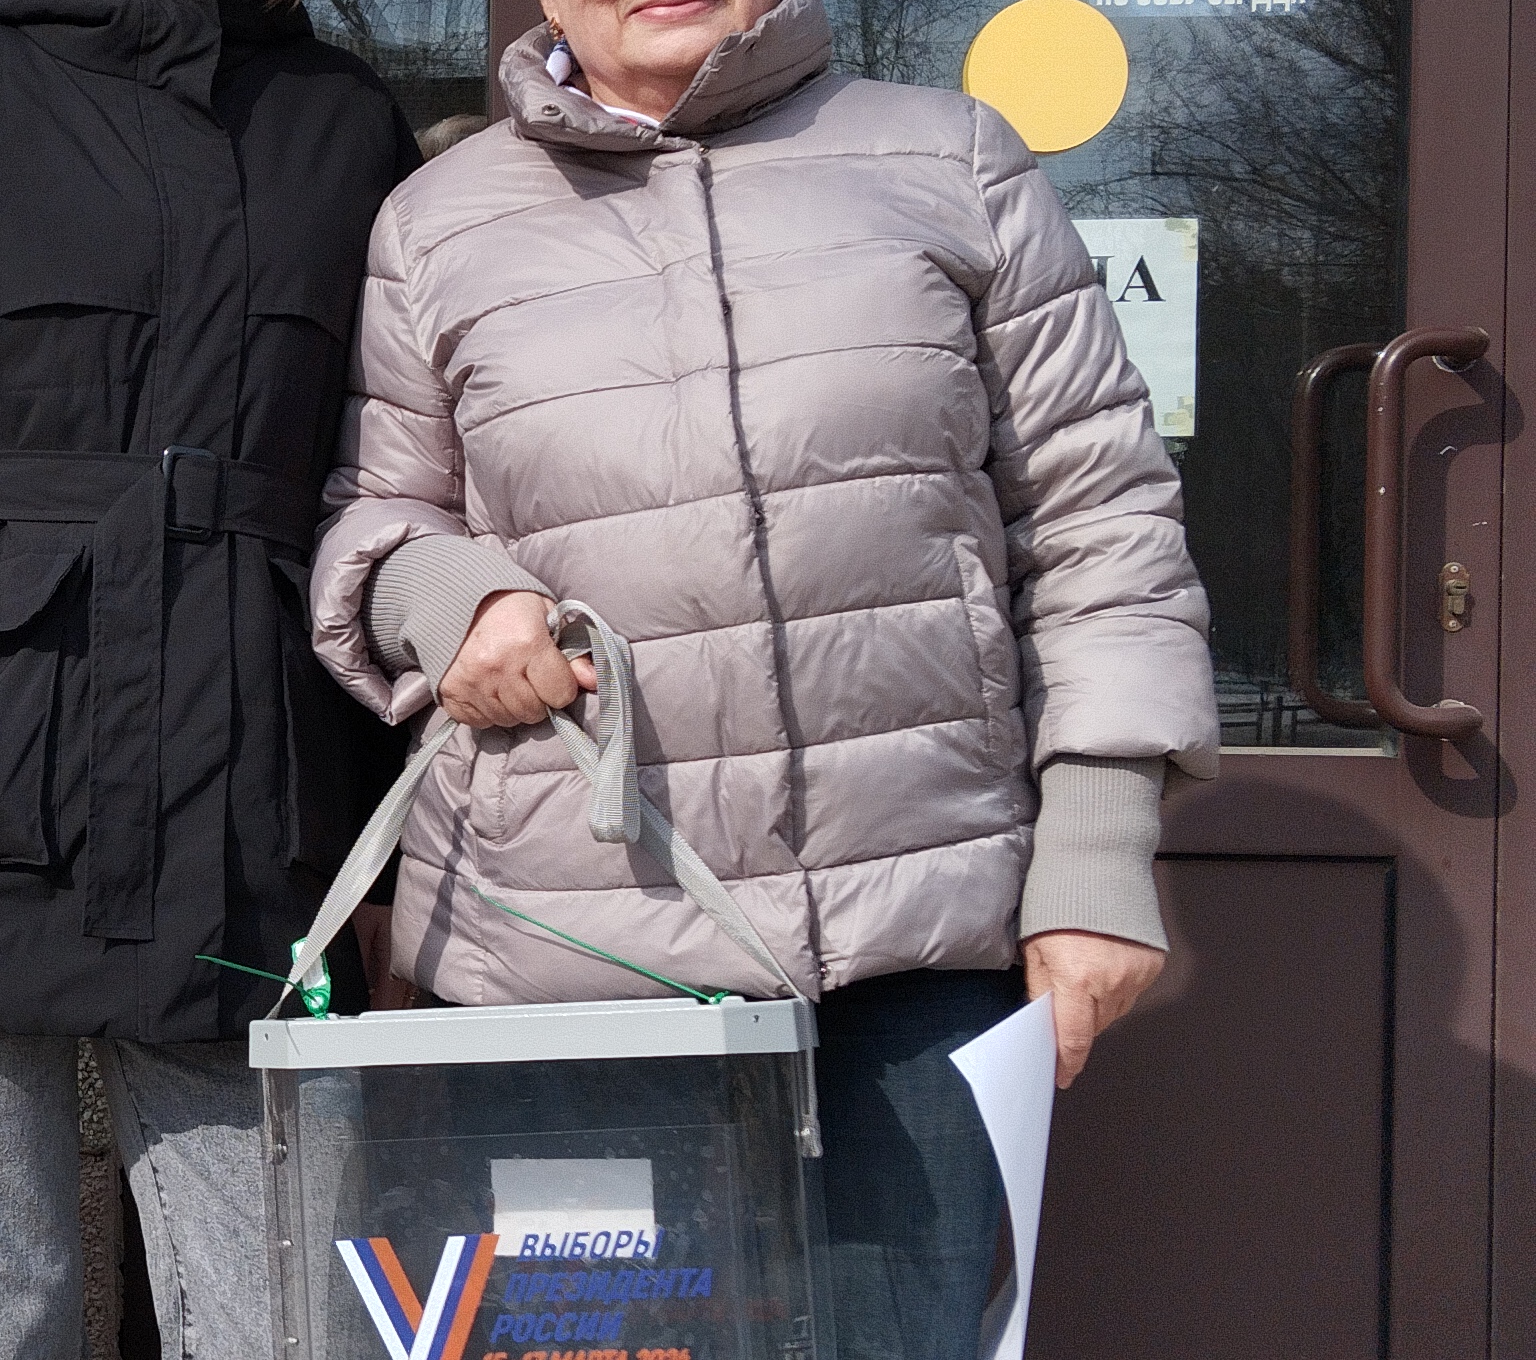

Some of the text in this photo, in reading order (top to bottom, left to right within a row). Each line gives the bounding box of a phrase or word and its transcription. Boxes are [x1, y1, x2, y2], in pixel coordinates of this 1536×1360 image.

[518, 1226, 665, 1262] ВЫБОРЫ
[504, 1267, 713, 1304] ПРЕЗИДЕНТА
[489, 1312, 623, 1343] РОССИИ
